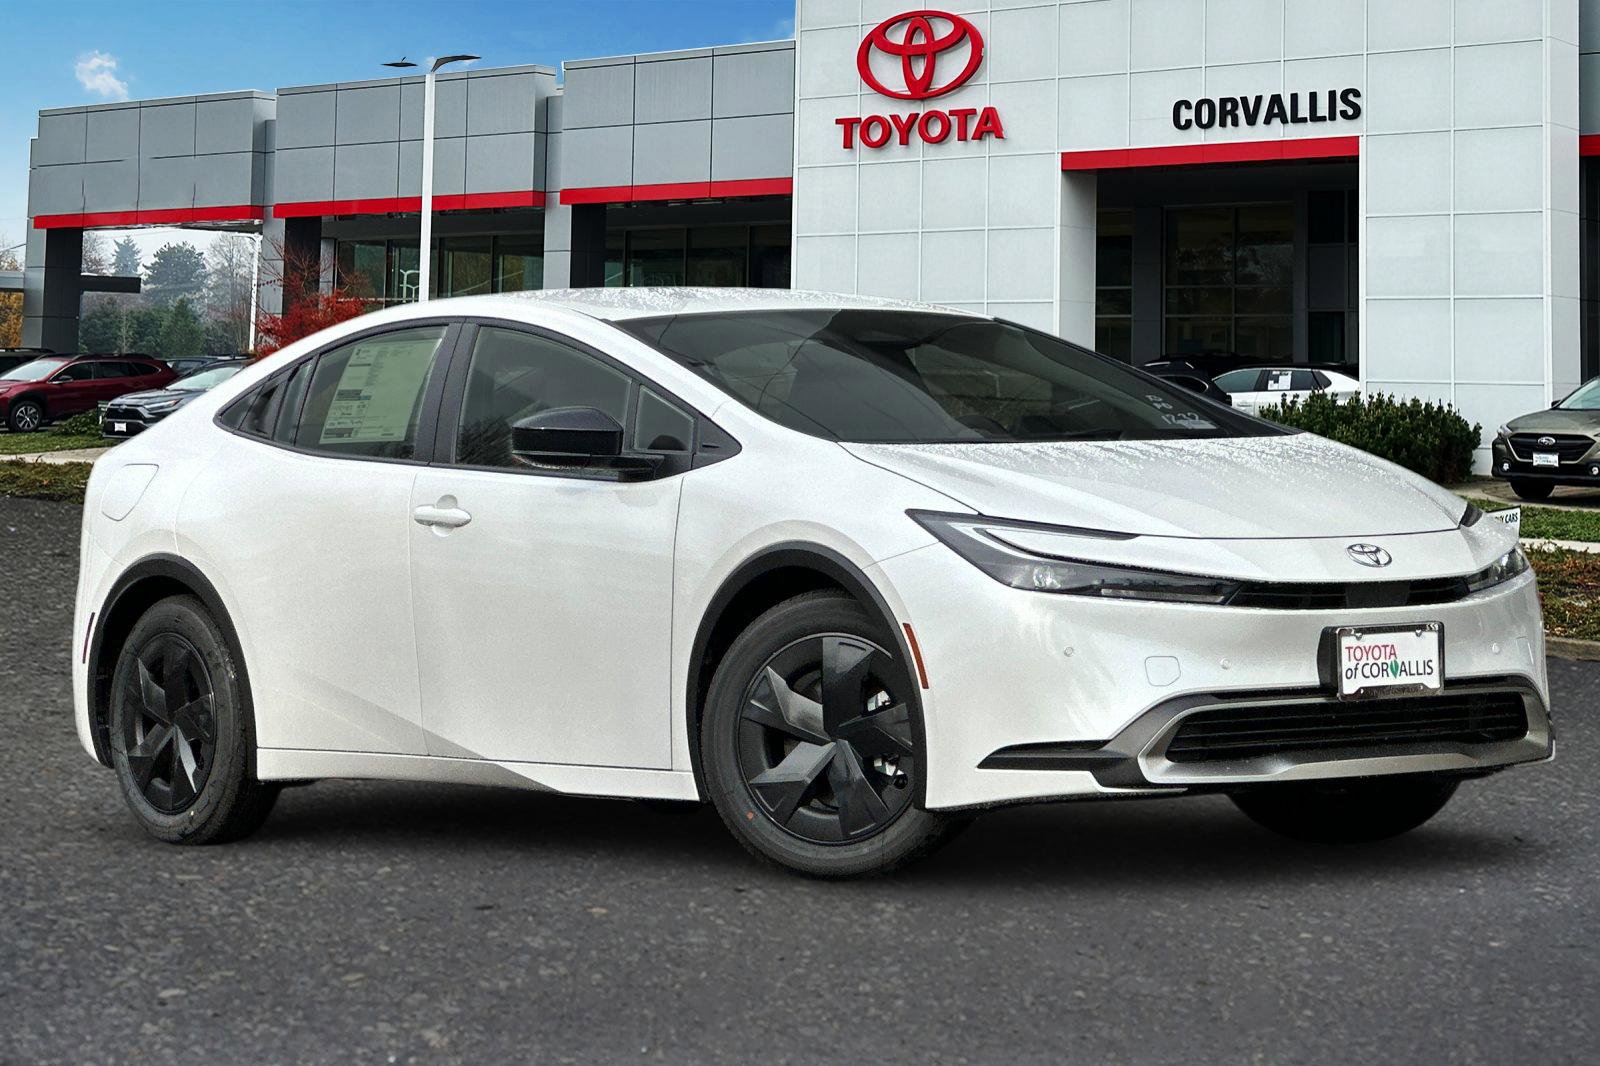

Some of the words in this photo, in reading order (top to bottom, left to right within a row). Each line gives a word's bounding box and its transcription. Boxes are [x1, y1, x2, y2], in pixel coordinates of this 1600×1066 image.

[1172, 87, 1362, 131] CORVALLIS
[835, 106, 1005, 150] TOYOTA
[1345, 644, 1397, 661] TOYOTA
[1345, 662, 1360, 680] of
[1361, 659, 1434, 679] CORVALLIS
